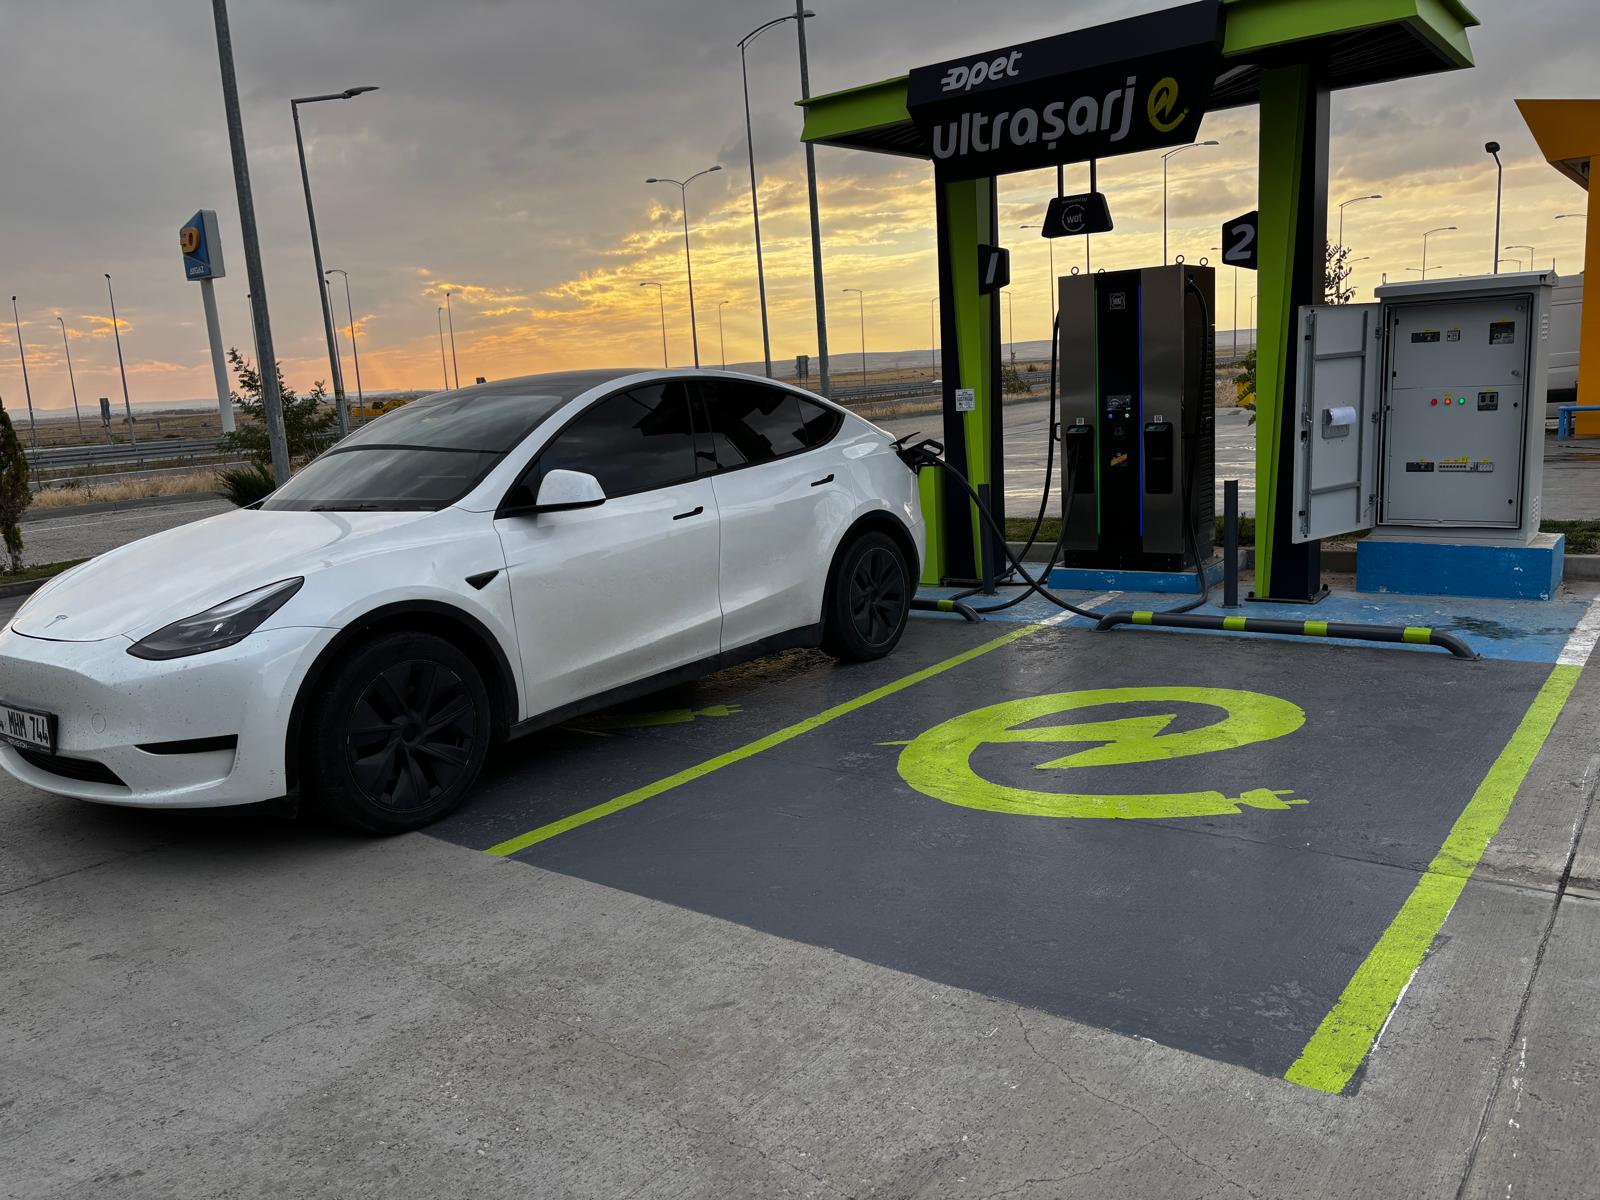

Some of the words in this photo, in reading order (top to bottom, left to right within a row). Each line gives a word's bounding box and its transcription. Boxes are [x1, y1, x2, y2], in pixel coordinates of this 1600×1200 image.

[933, 75, 1137, 159] ultraşarj
[1225, 223, 1255, 261] 2
[29, 716, 49, 744] 744
